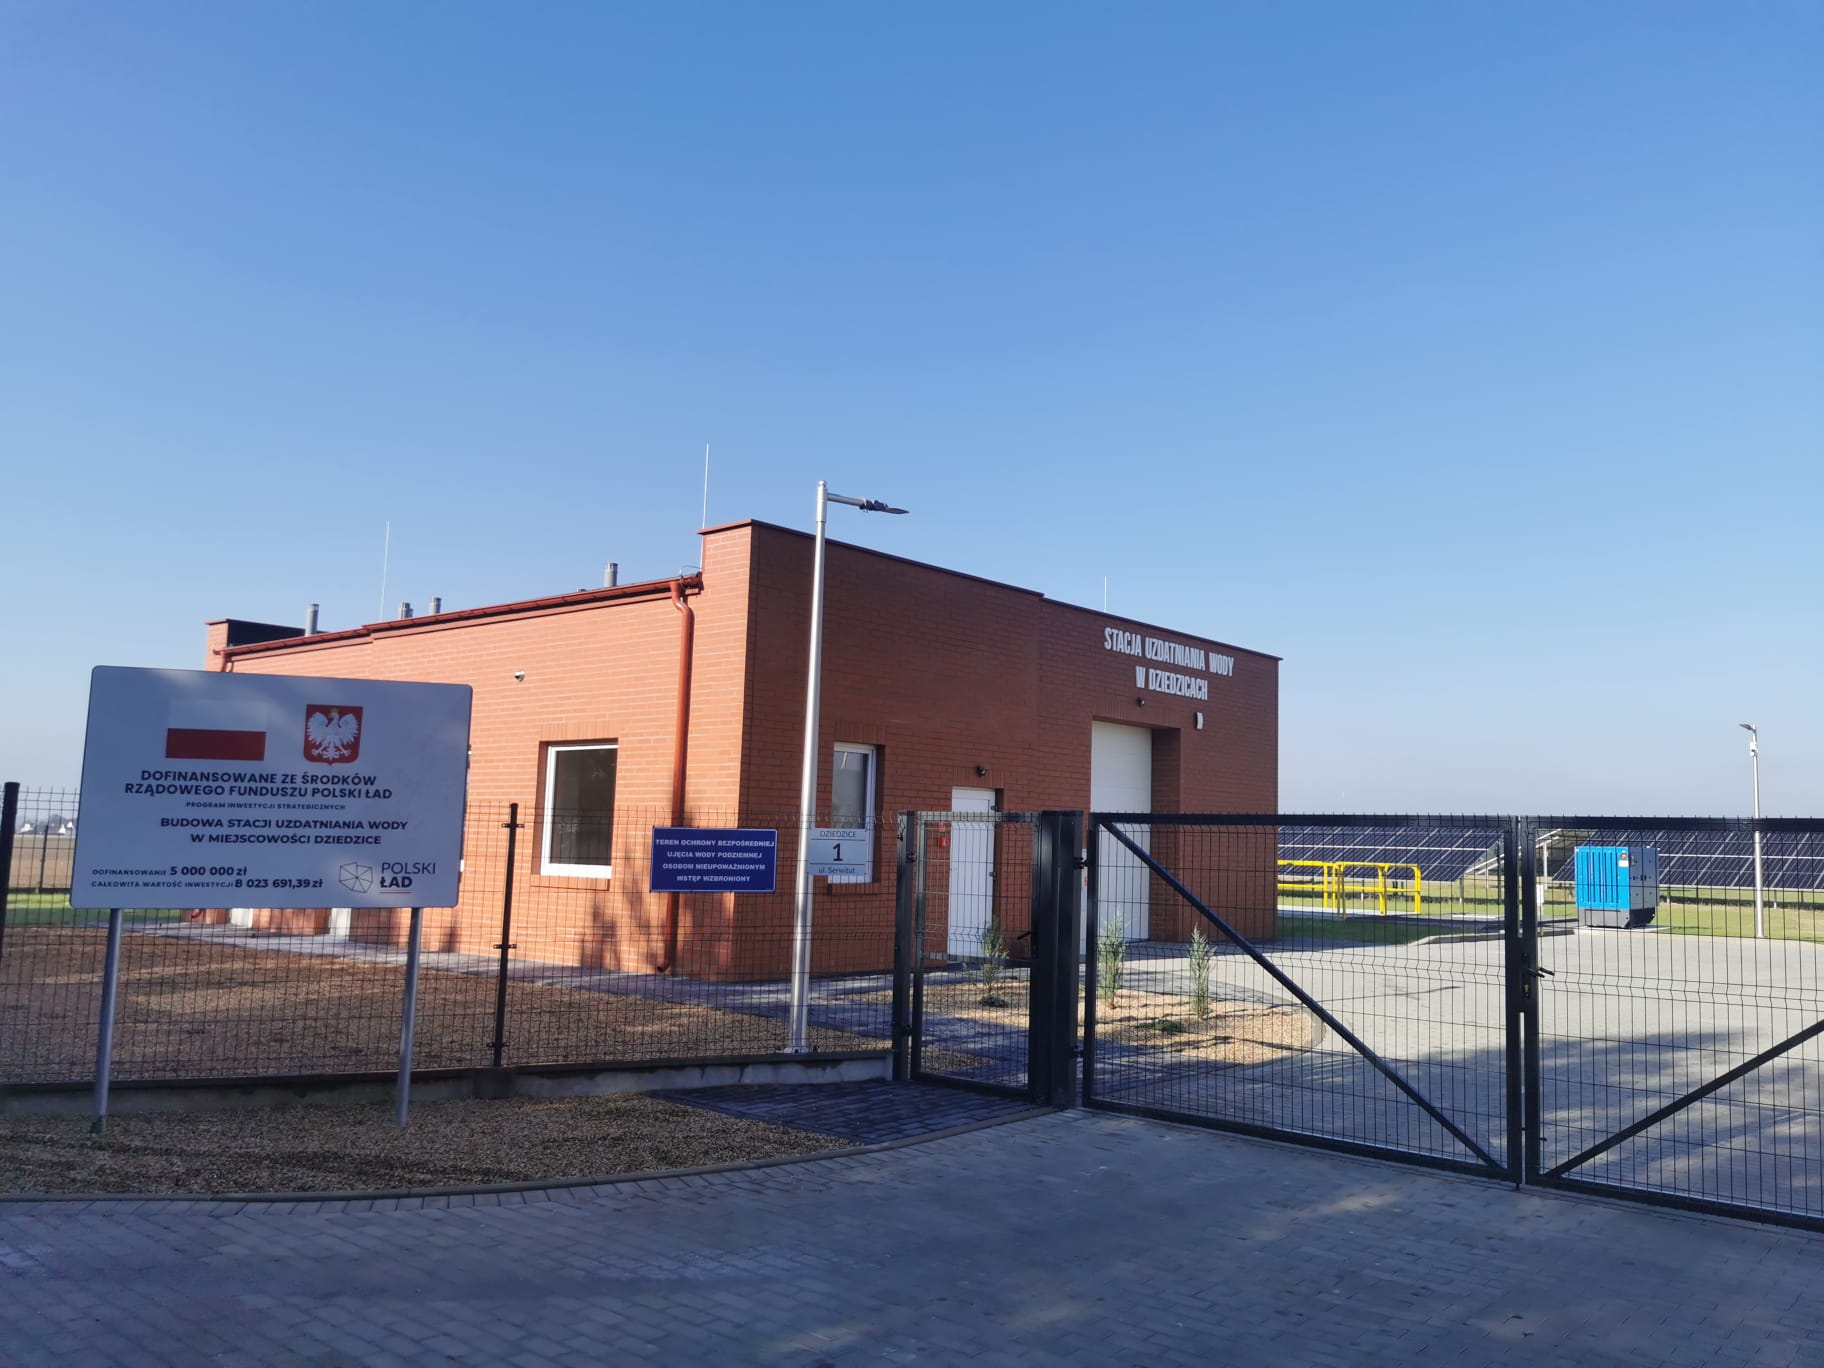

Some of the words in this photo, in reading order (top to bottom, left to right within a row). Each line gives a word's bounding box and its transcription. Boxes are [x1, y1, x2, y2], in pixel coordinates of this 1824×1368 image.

[1104, 627, 1142, 657] STACJA
[1145, 637, 1205, 671] UZDATNIANIA
[1209, 651, 1234, 677] WODY
[1135, 665, 1146, 689] W
[1149, 668, 1208, 700] DZIEDZICACH
[141, 770, 277, 784] DOFINANSOWANE
[281, 773, 297, 784] ZE
[301, 771, 377, 786] ŚRODKÓW
[124, 783, 225, 797] RZĄDOWEGO
[229, 785, 308, 798] FUNDUSZU
[311, 787, 362, 798] POLSKI
[365, 788, 393, 799] ŁAD
[160, 817, 224, 828] BUDOWA
[227, 818, 272, 828] STACJI
[275, 819, 364, 830] UZDATNIANIA
[368, 820, 408, 831] WODY
[190, 833, 205, 843] W
[208, 832, 311, 845] MIEJSCOWOŚCI
[314, 834, 382, 845] DZIEDZICE
[820, 830, 857, 838] DZIEDZICE
[656, 838, 679, 846] TEREN
[681, 839, 715, 847] OCHRONY
[718, 839, 774, 847] BEZPOŚREDNIEJ
[667, 851, 694, 859] UJĘCIA
[833, 842, 843, 862] 1
[169, 866, 178, 876] 5
[180, 866, 206, 876] 000
[209, 866, 234, 876] 000
[236, 866, 247, 876] zł
[381, 861, 436, 875] POLSKI
[184, 880, 234, 889] INWESTYCJI
[234, 878, 243, 888] 8
[246, 878, 269, 888] 023
[272, 878, 311, 890] 691,39
[312, 878, 324, 888] zł
[380, 875, 412, 888] ŁAD
